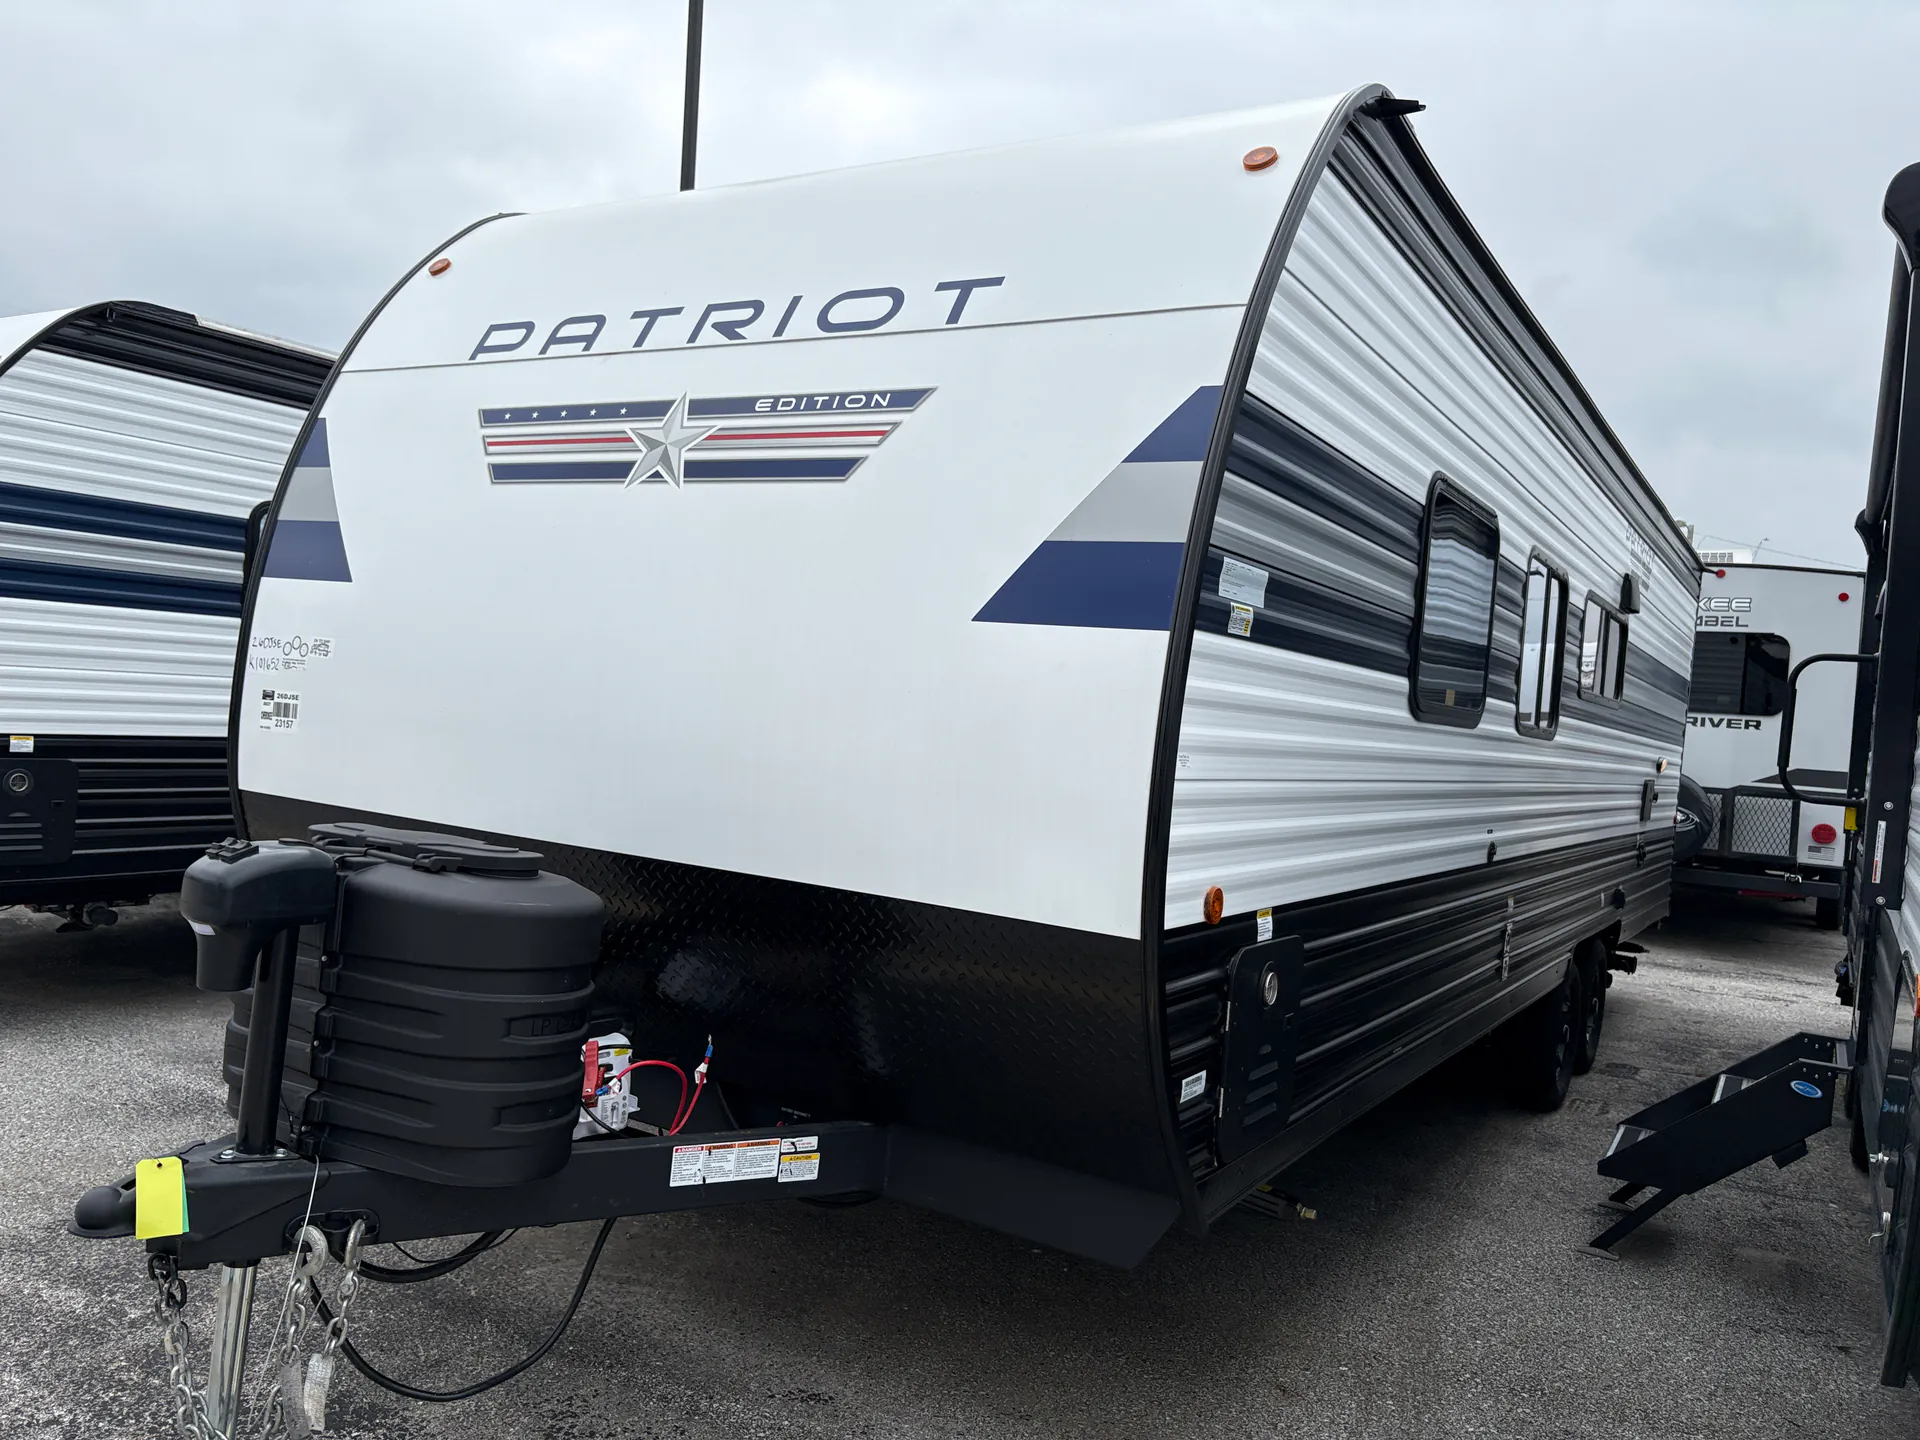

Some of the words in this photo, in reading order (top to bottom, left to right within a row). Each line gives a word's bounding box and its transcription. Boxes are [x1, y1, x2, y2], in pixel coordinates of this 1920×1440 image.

[468, 276, 1006, 361] PATRIOT
[754, 393, 892, 412] EDITION
[276, 693, 300, 701] 26DJSE
[274, 719, 294, 729] 23157
[1686, 716, 1762, 730] RIVER
[530, 1018, 551, 1037] LP
